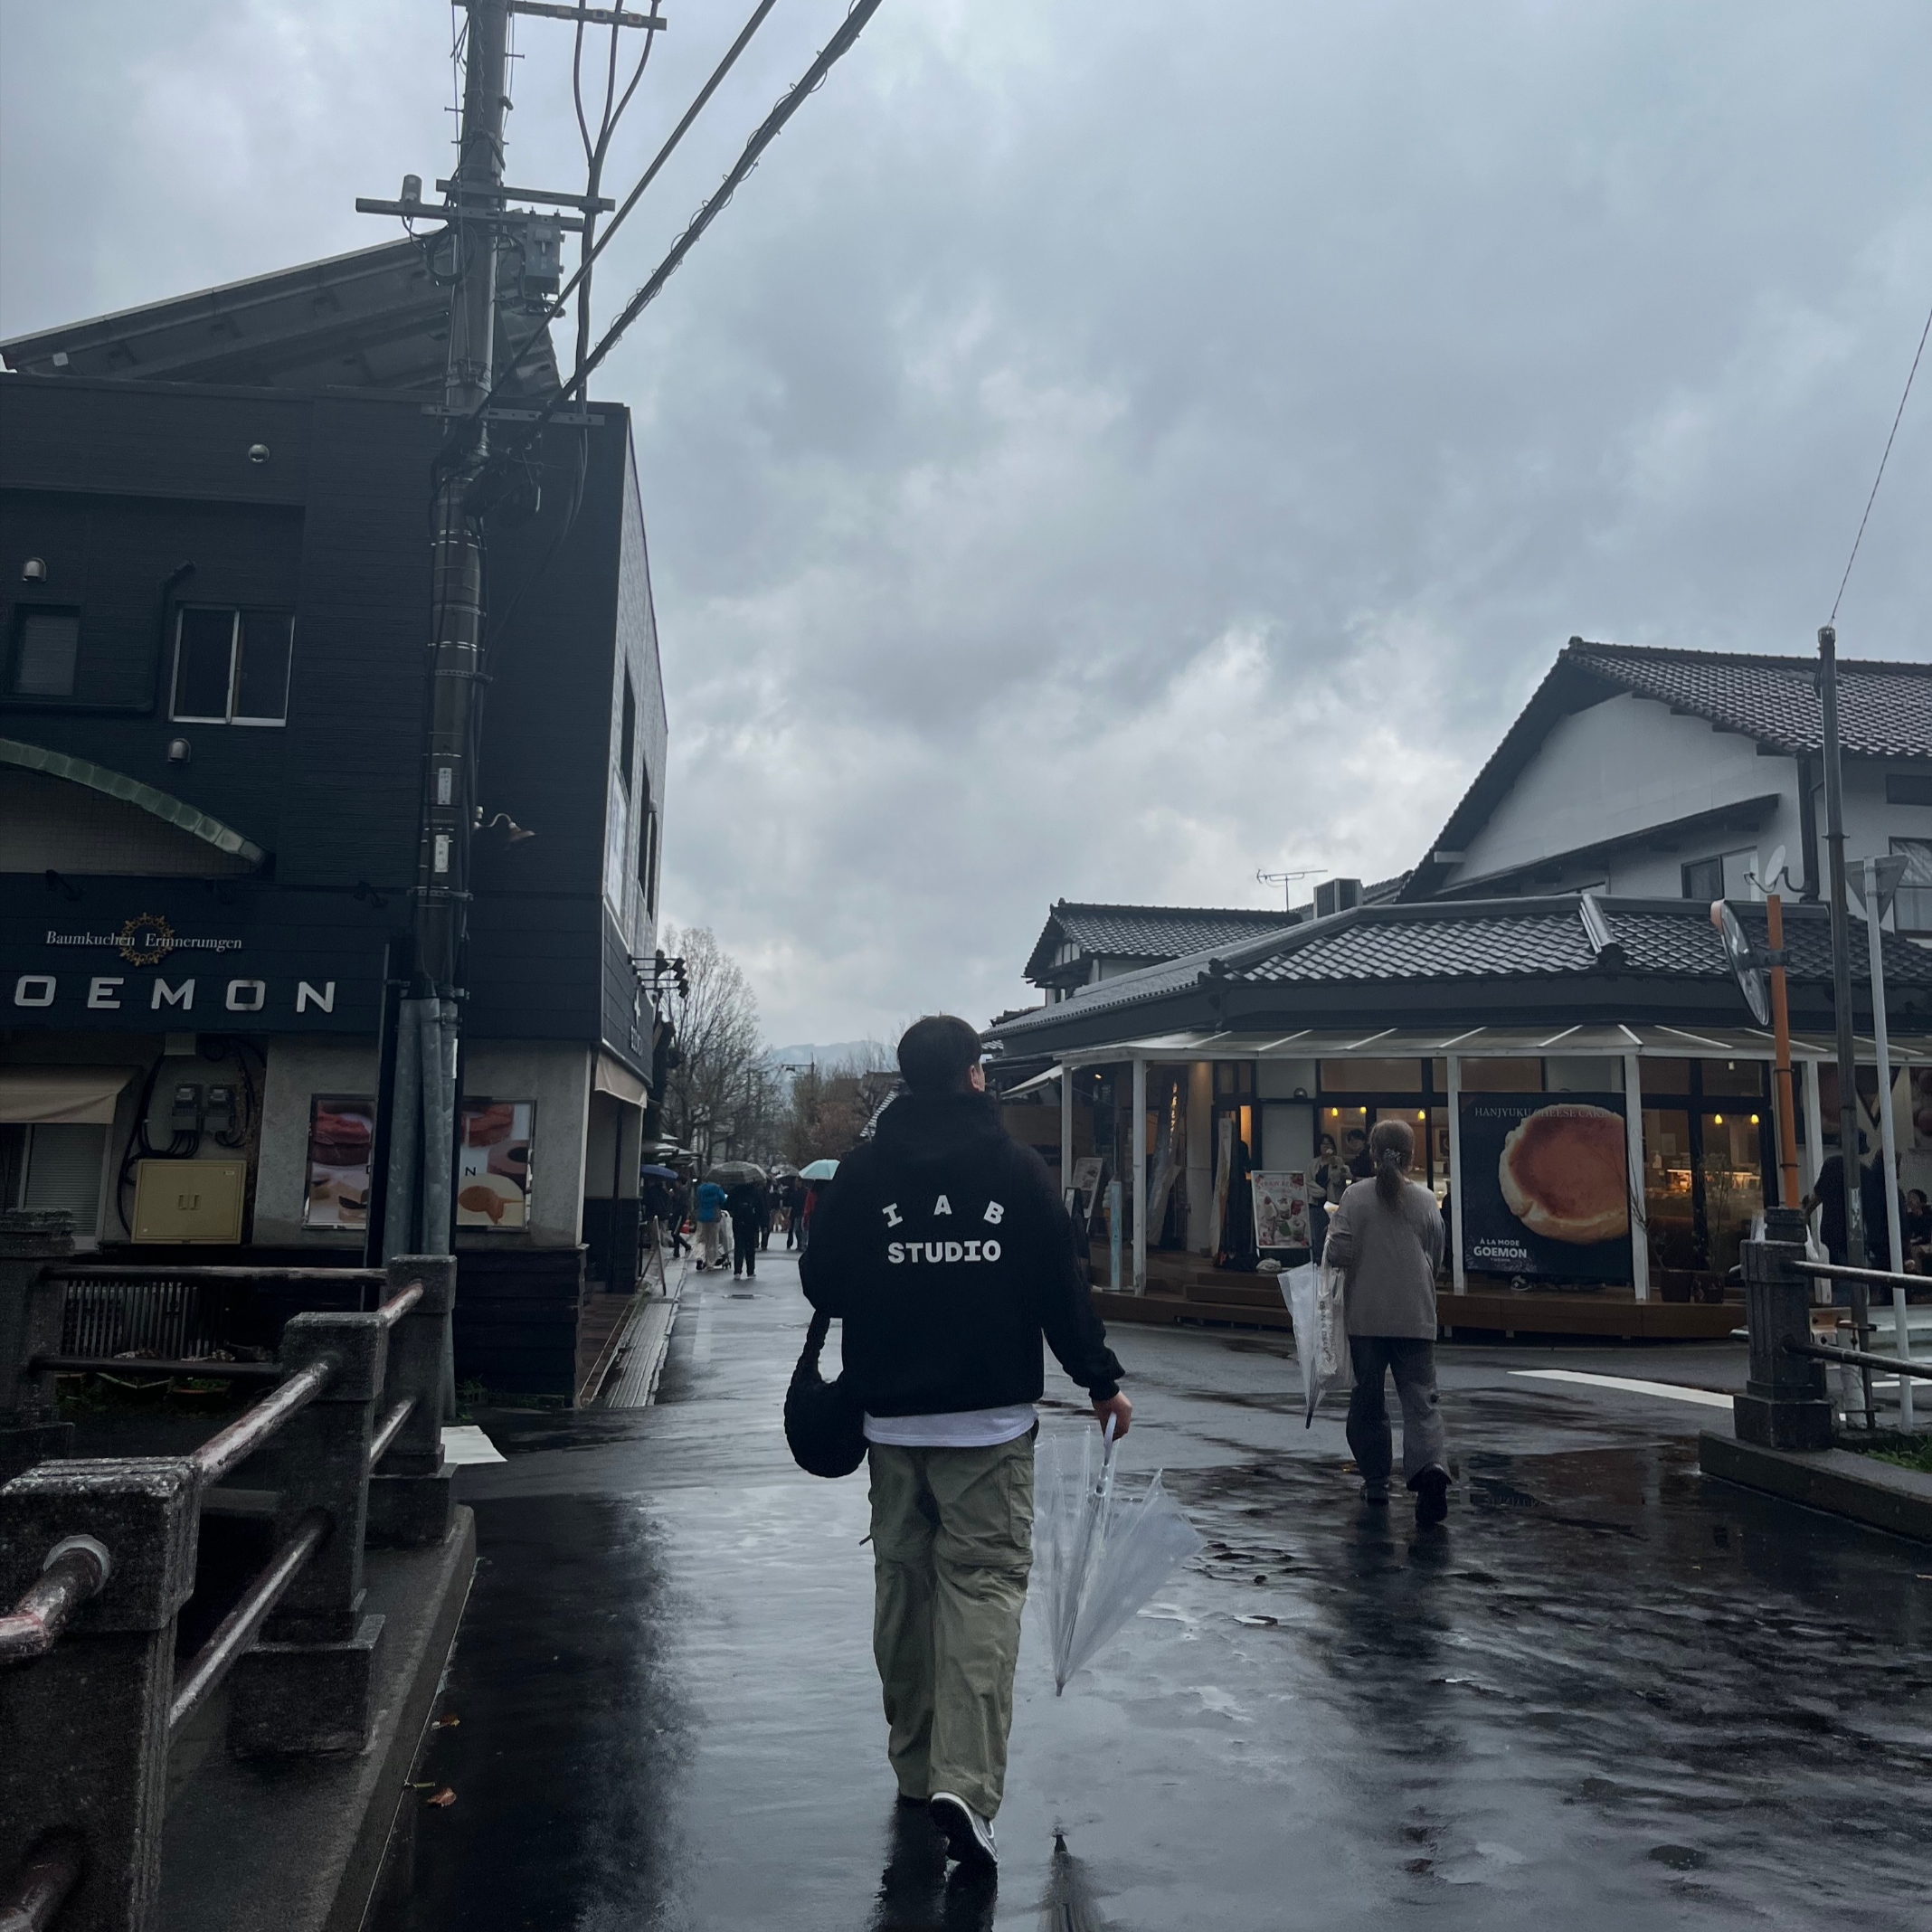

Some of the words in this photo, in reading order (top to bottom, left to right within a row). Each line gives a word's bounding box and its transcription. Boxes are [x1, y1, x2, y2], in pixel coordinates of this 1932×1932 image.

[46, 930, 136, 946] Baumkuchen
[1486, 1238, 1497, 1246] LA
[1497, 1239, 1520, 1247] MODE
[887, 1239, 1001, 1264] STUDIO
[1473, 1245, 1528, 1259] GOEMON
